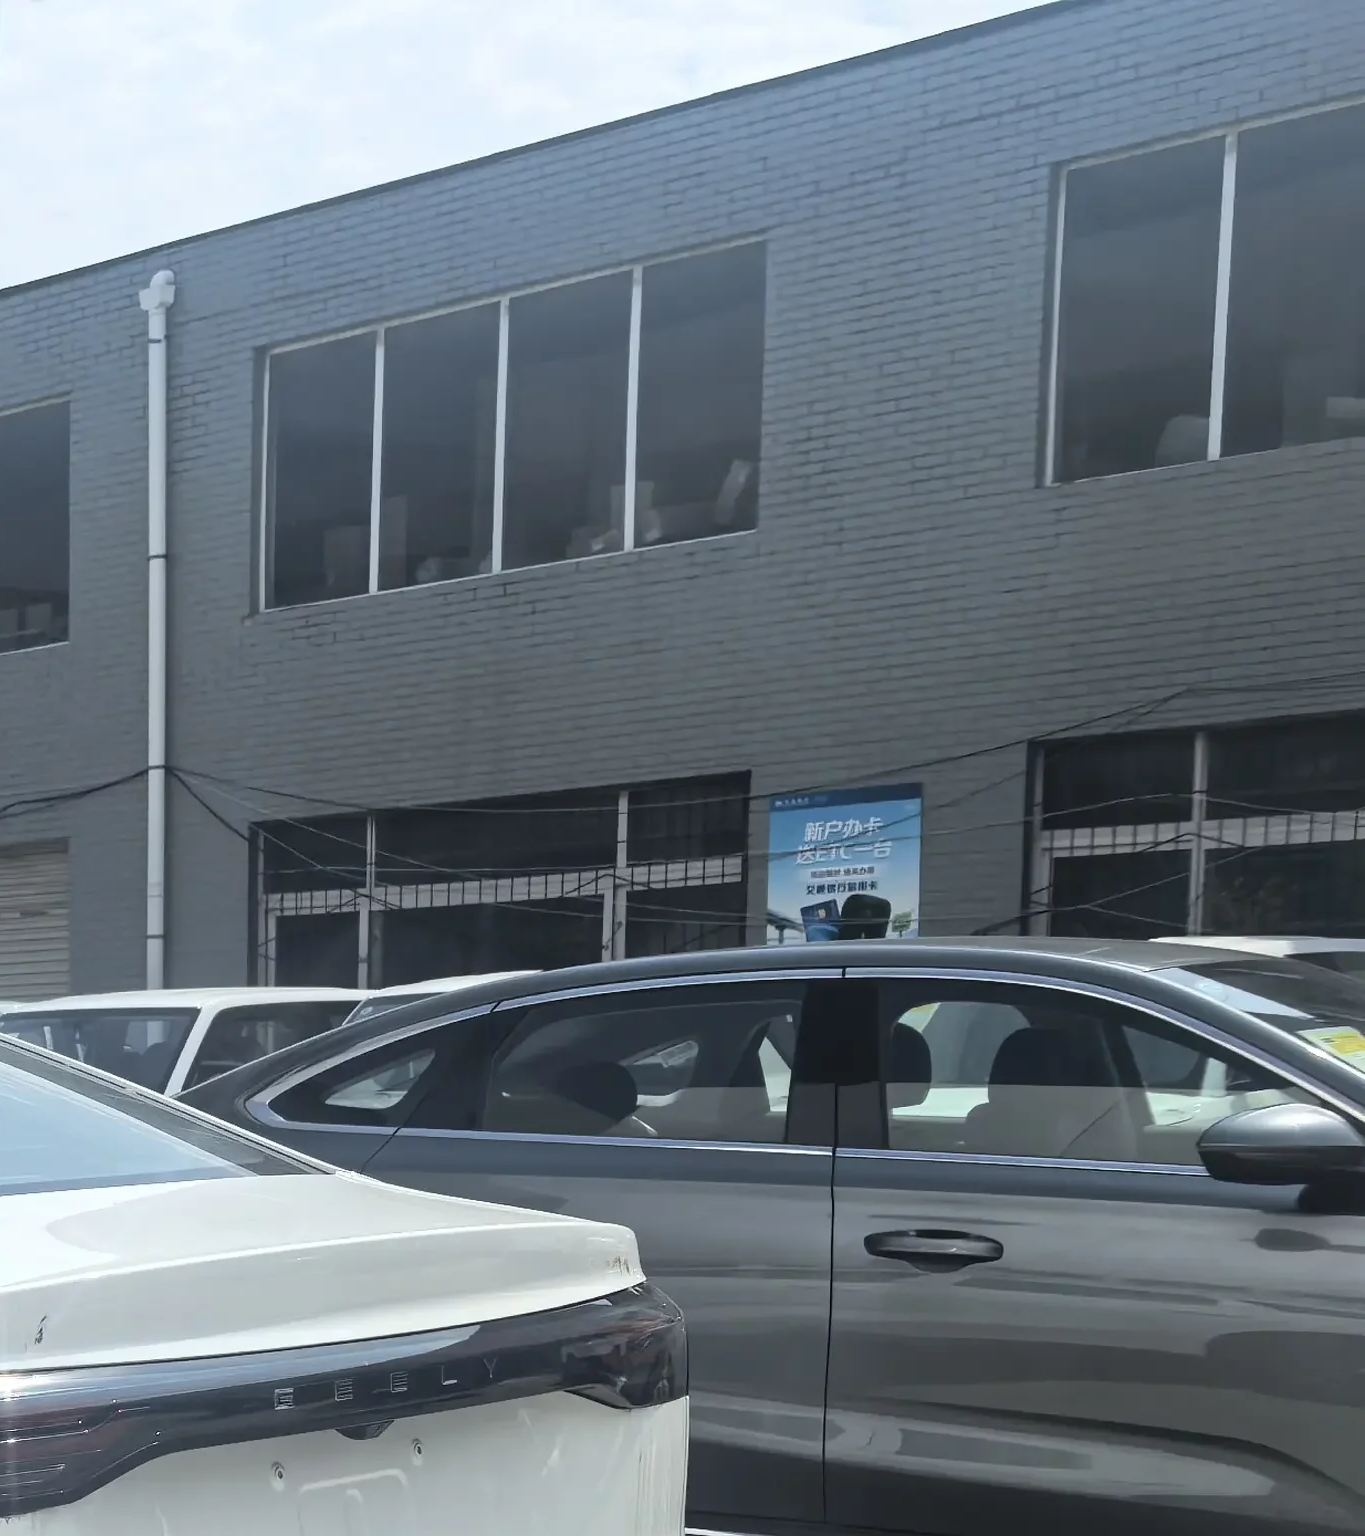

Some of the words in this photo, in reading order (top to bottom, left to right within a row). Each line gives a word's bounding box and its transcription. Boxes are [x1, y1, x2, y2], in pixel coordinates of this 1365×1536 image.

[804, 816, 884, 842] 新户办卡
[273, 1355, 498, 1411] GEELY
